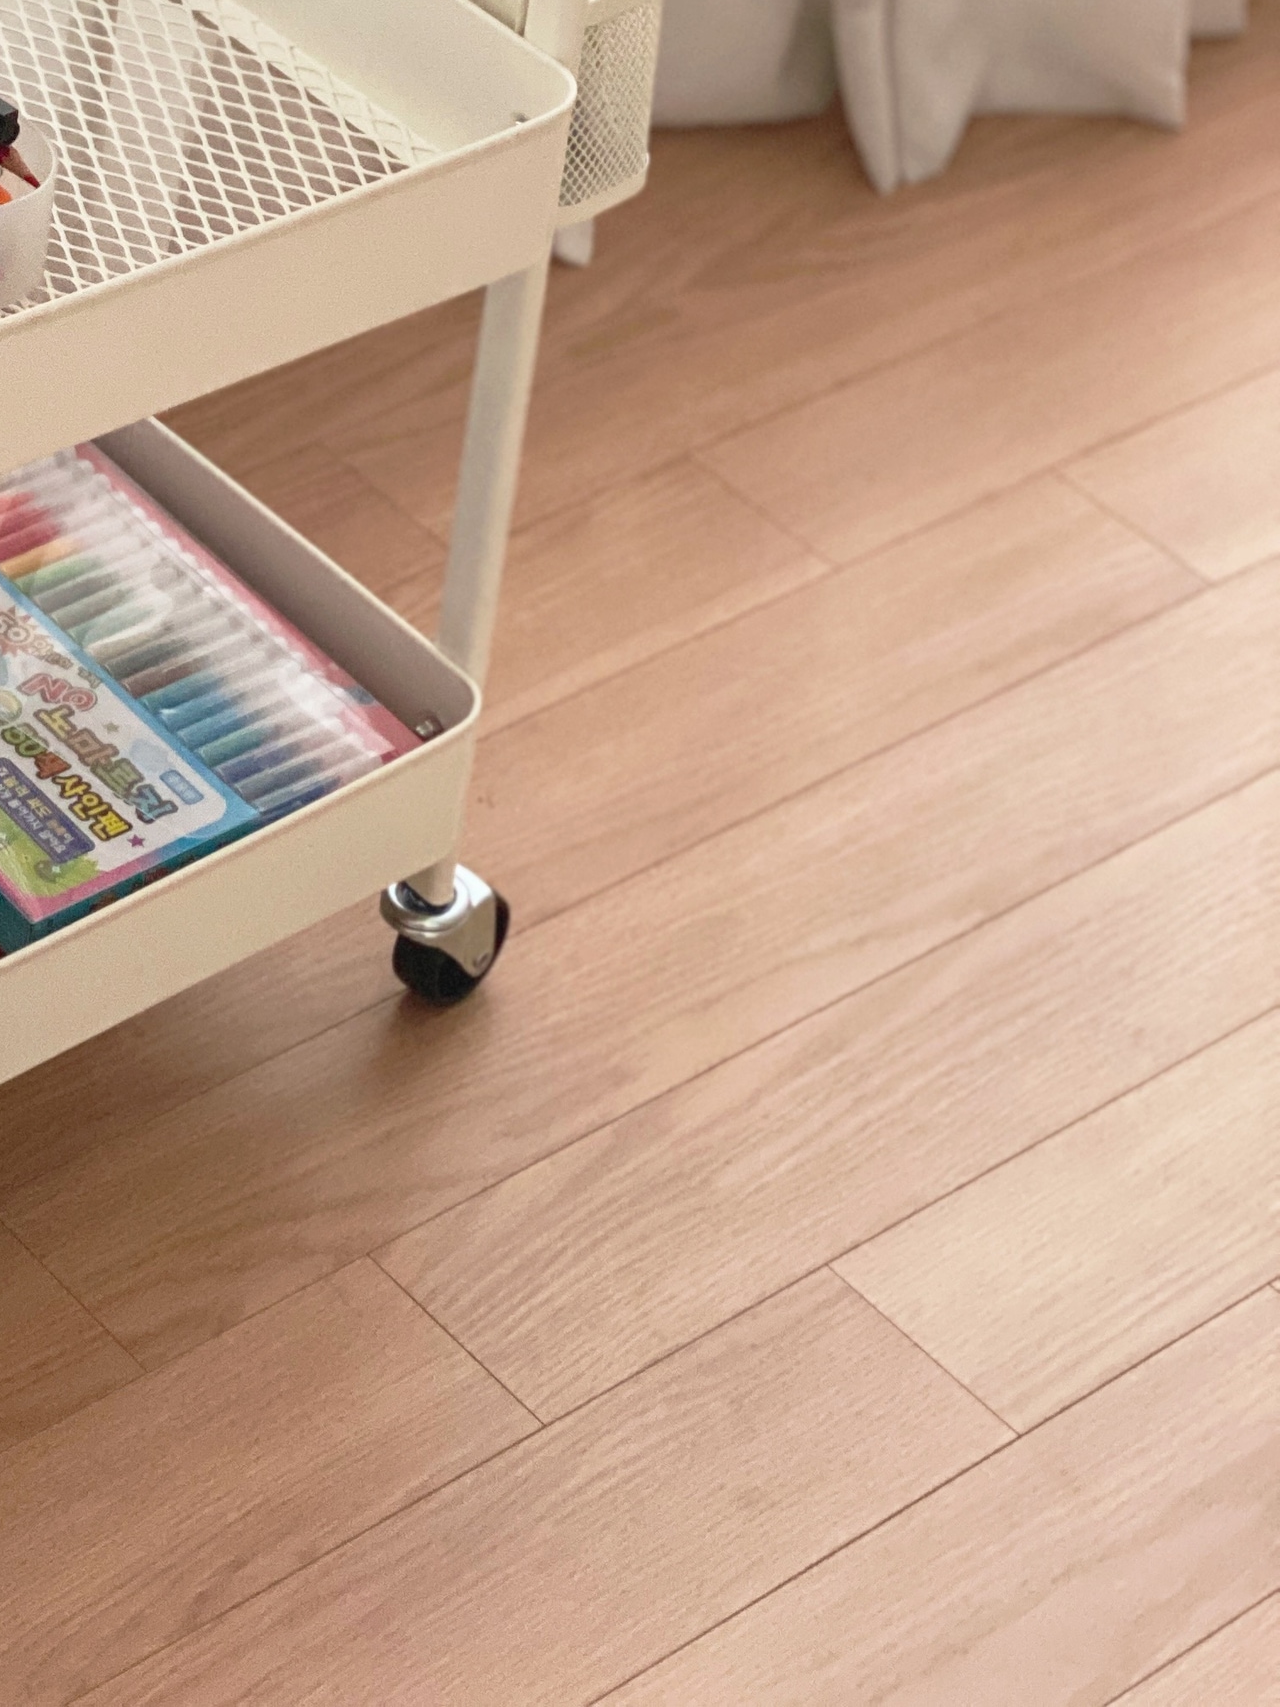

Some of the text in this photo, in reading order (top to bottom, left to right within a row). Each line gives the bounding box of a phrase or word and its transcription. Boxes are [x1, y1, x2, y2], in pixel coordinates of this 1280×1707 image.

[16, 672, 98, 712] NO
[33, 704, 179, 824] 노마르지
[51, 773, 134, 842] 사인펜
